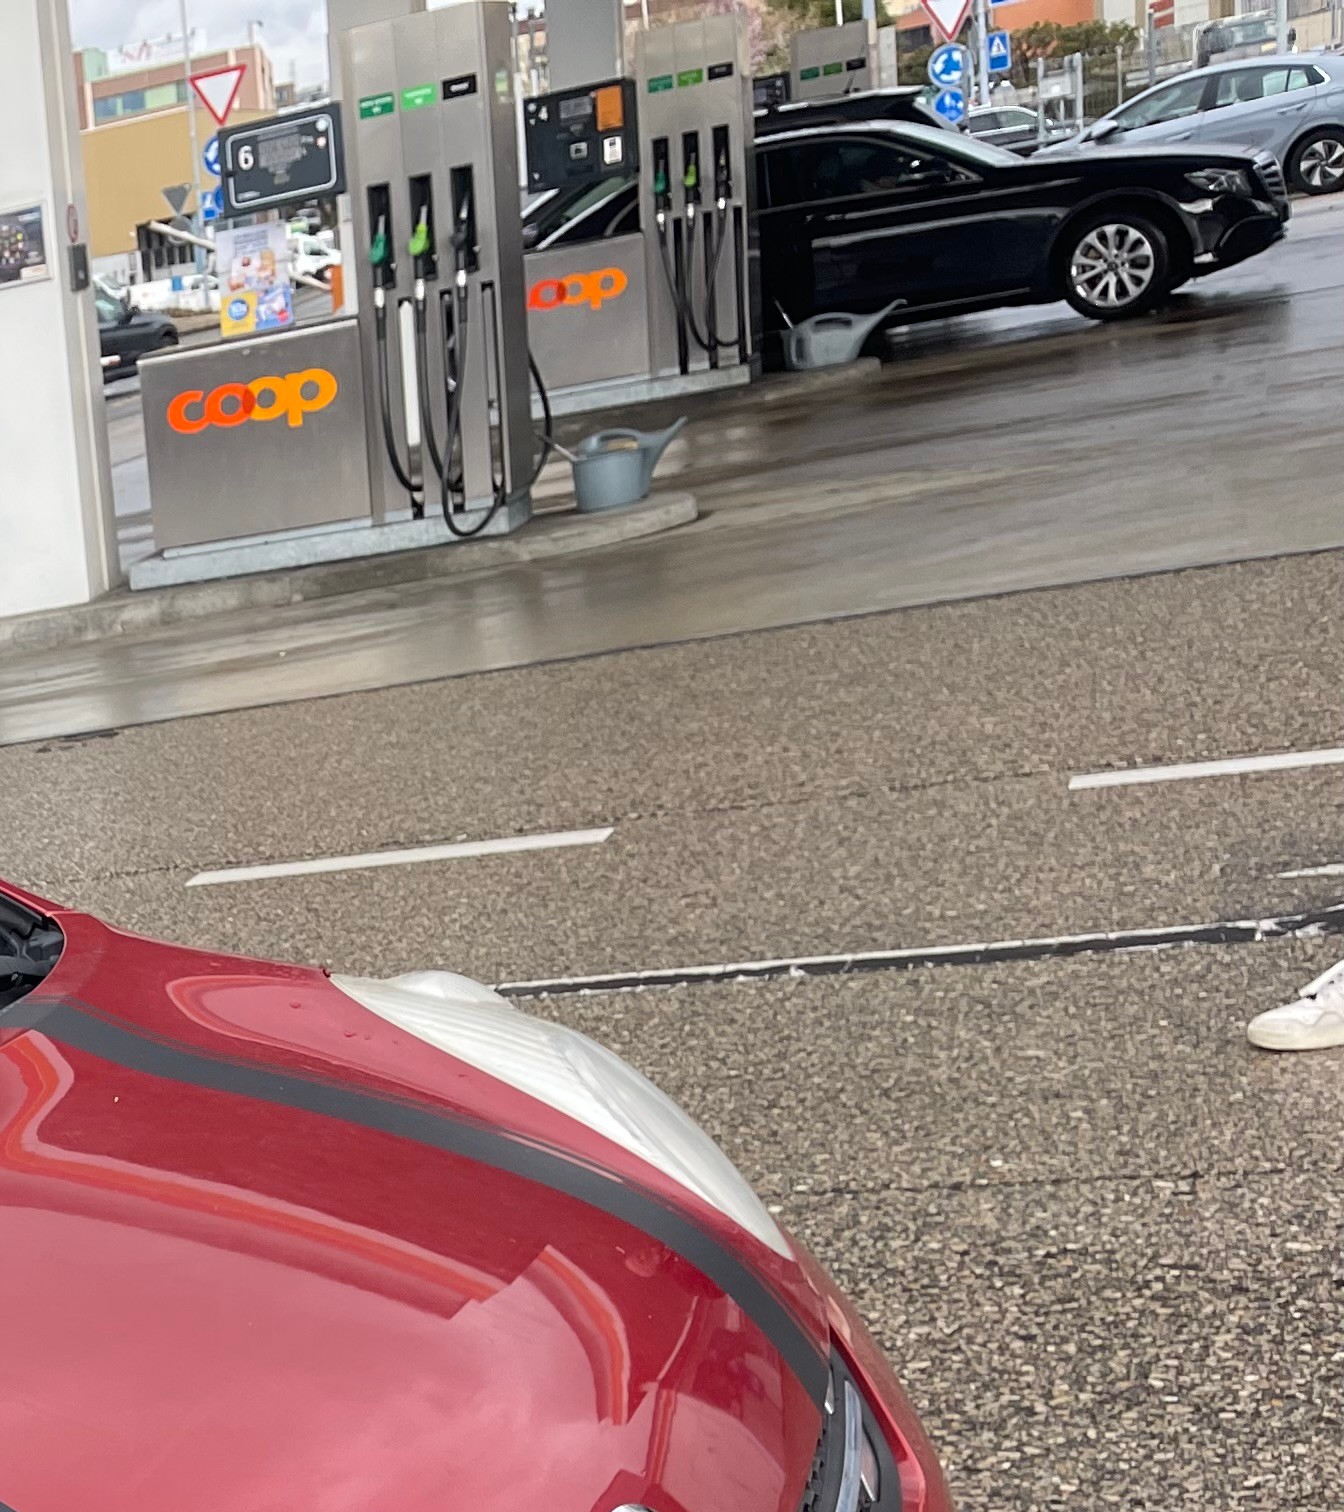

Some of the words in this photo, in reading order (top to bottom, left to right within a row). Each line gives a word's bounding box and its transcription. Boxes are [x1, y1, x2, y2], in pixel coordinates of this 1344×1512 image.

[237, 145, 255, 171] 6
[527, 267, 628, 311] oop
[166, 368, 338, 435] coop
